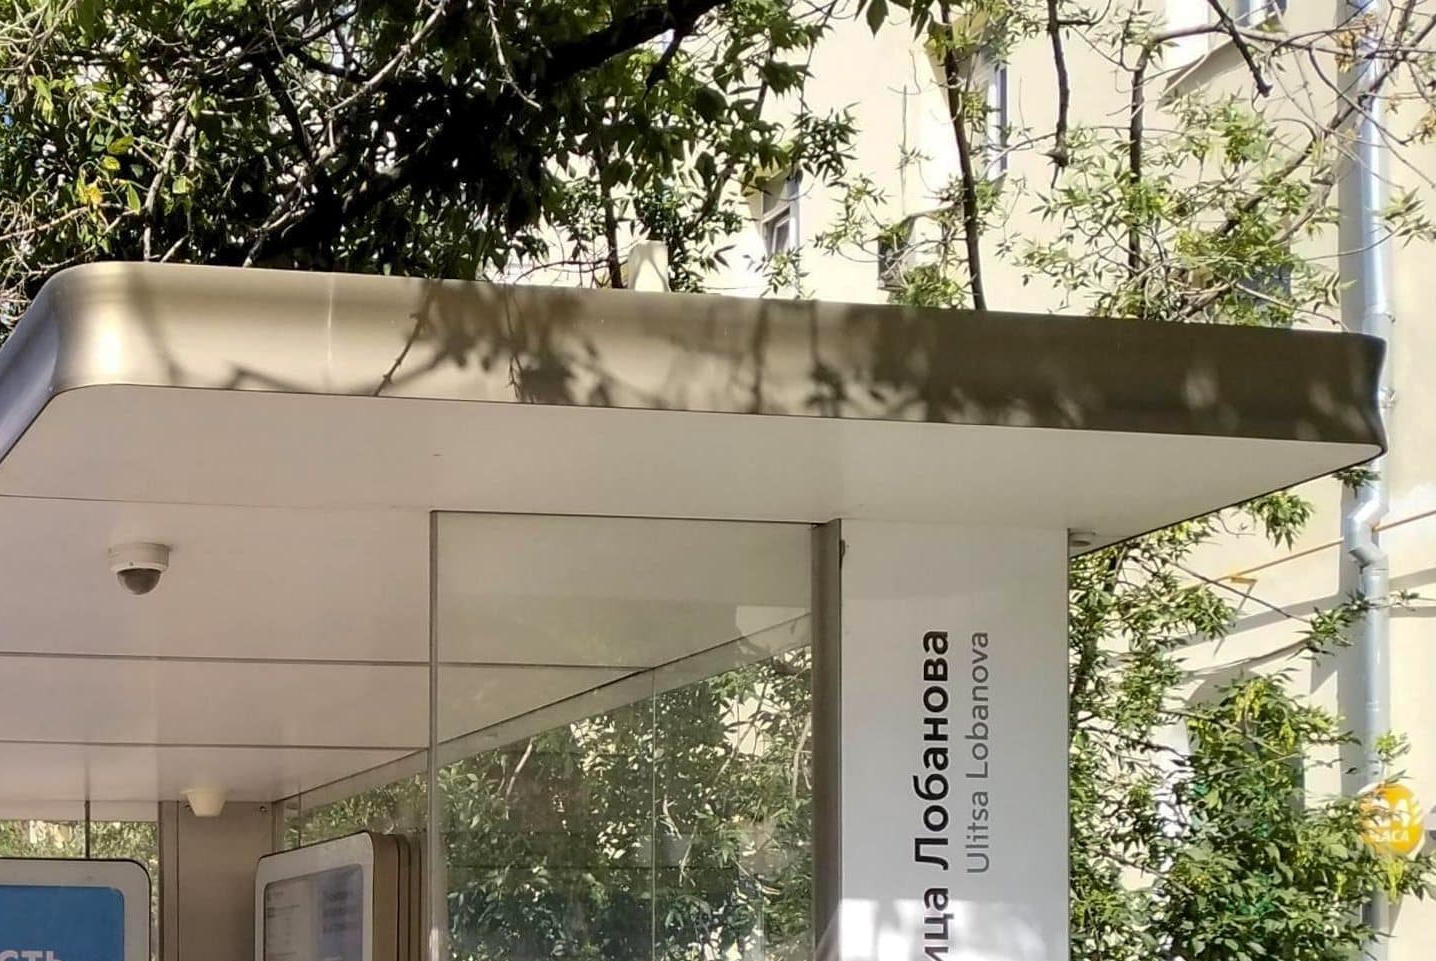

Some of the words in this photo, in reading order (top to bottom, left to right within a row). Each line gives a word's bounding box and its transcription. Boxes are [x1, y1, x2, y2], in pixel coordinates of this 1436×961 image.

[913, 630, 949, 870] Лобанова
[965, 631, 989, 779] Lobanova
[965, 791, 990, 873] Ulitsa
